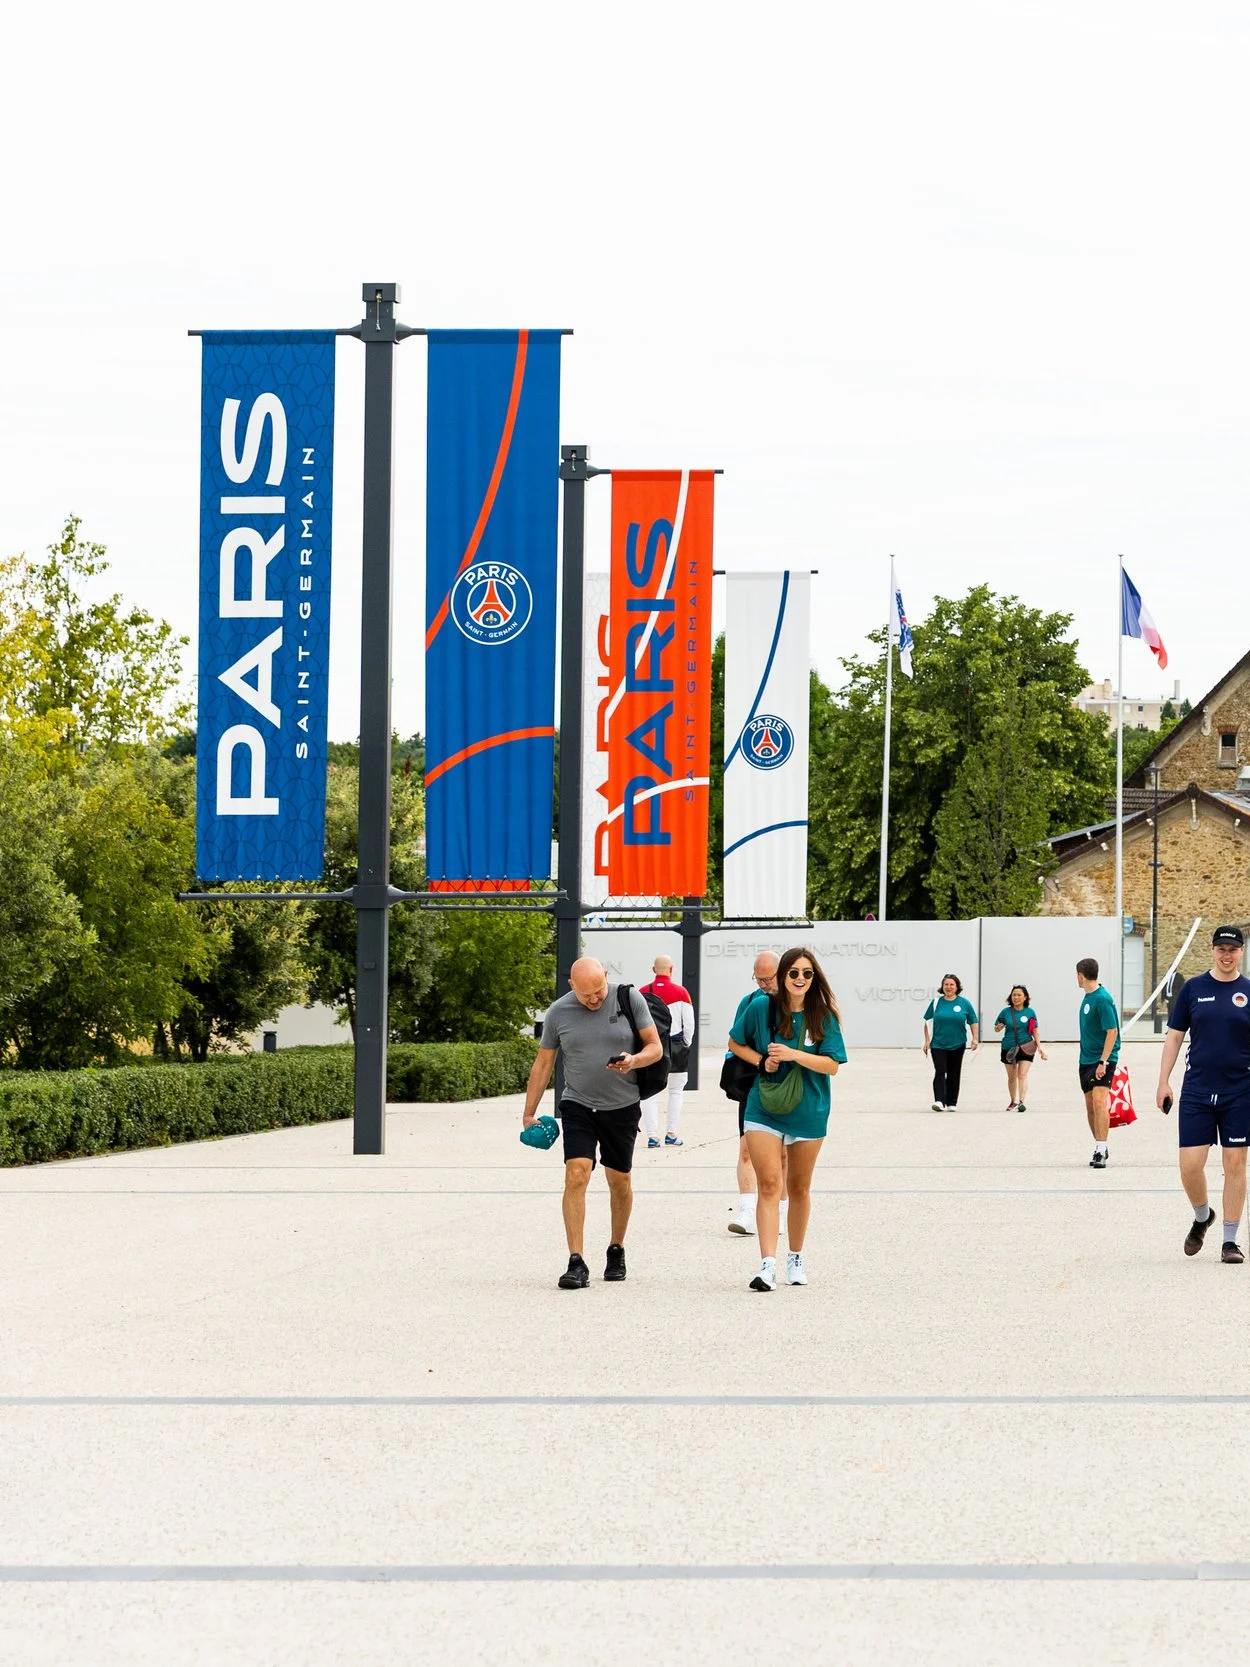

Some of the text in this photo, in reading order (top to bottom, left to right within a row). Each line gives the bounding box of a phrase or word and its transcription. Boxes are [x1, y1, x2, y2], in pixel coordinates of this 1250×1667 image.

[216, 392, 288, 816] PARIS
[296, 447, 315, 759] SAINT-GERMAIN
[464, 565, 519, 586] PARIS
[624, 518, 677, 845] PARIS
[684, 561, 698, 802] SAINT-GERMAIN
[749, 719, 785, 732] PARIS
[854, 986, 936, 1002] VICTOI
